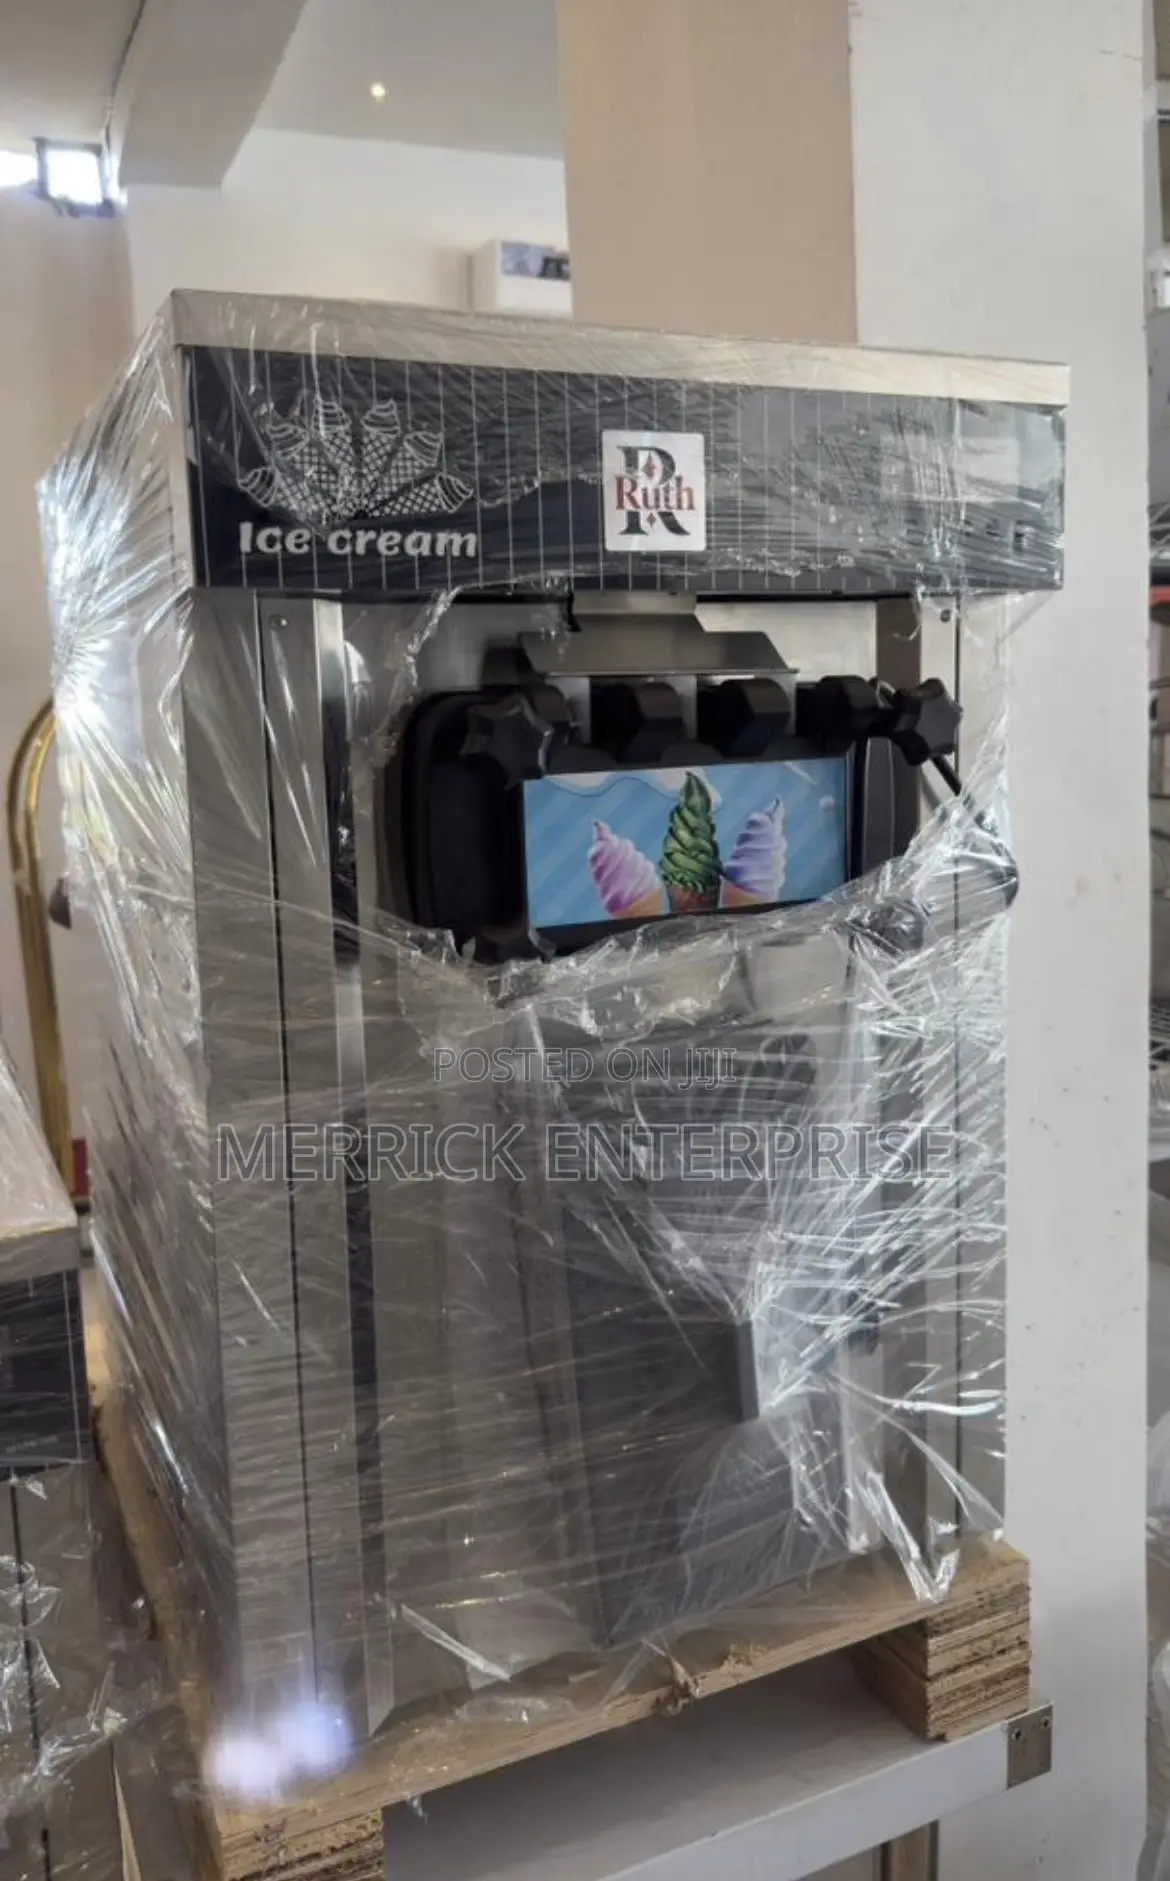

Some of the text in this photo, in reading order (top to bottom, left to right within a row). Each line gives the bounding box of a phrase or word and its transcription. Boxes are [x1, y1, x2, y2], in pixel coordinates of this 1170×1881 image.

[615, 474, 696, 513] Ruth
[239, 522, 478, 558] Ice cream
